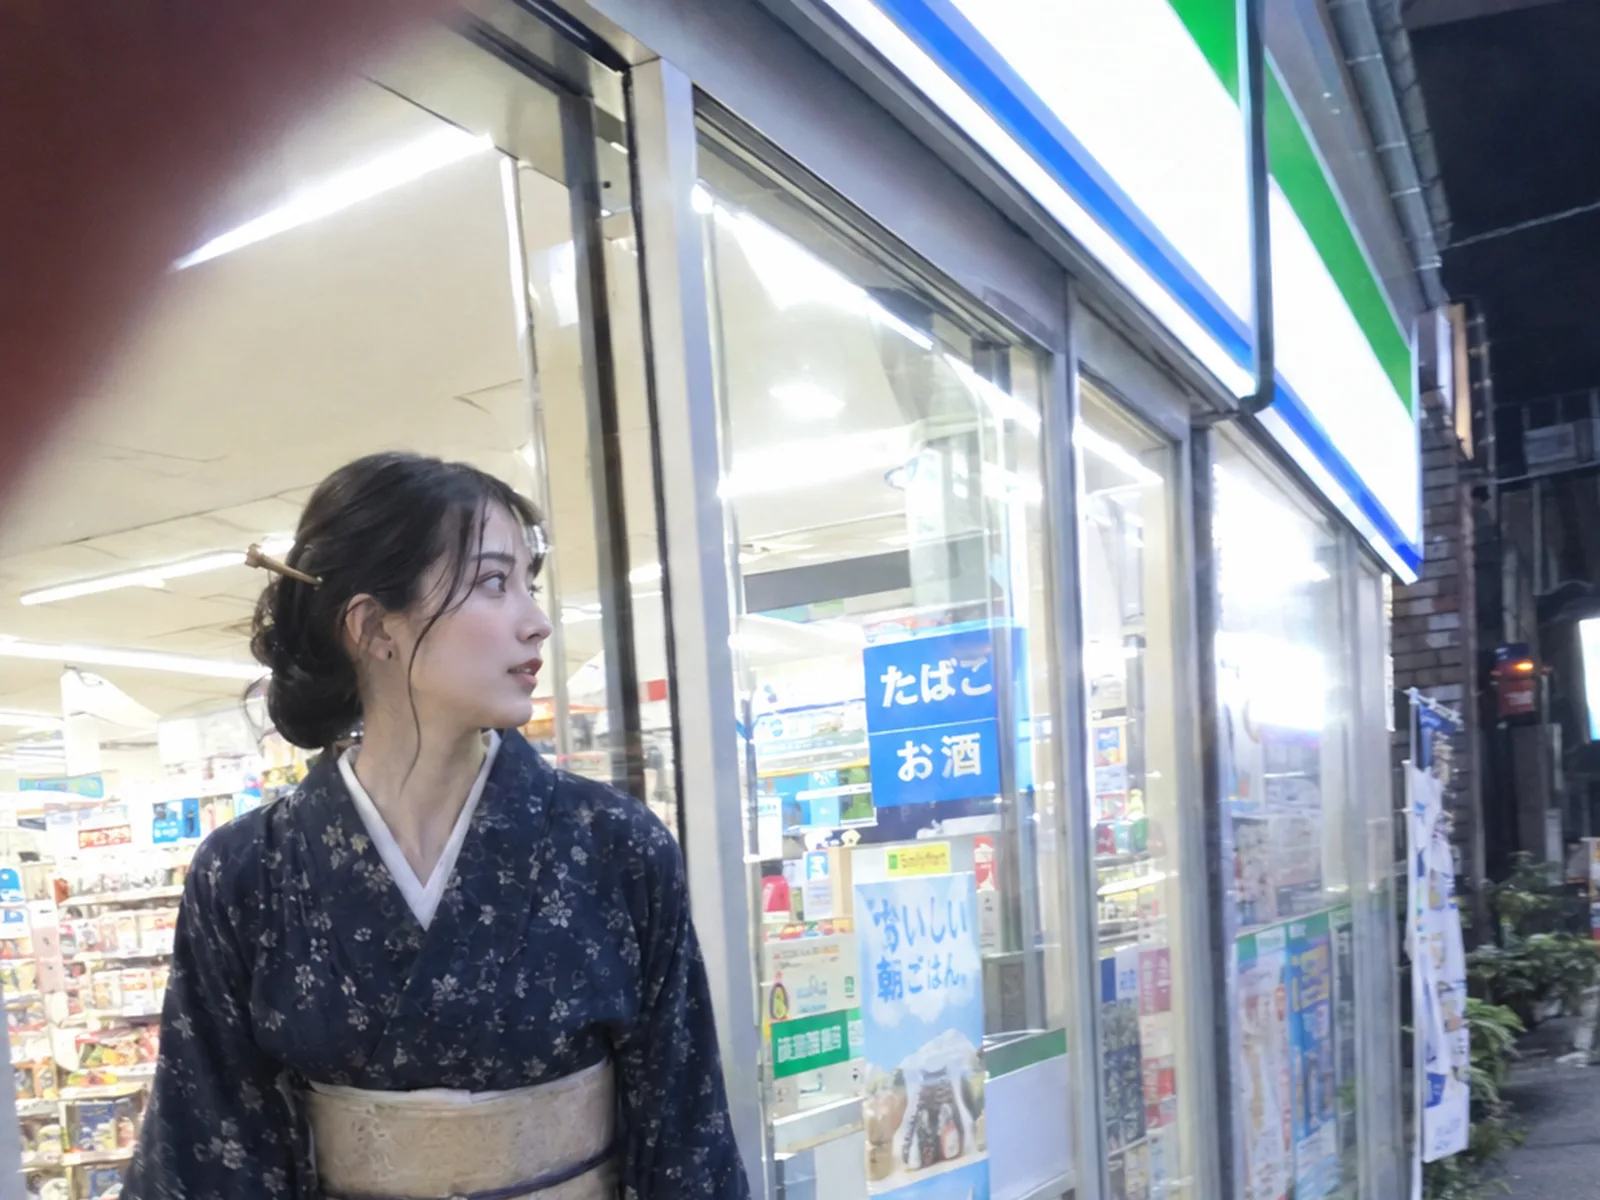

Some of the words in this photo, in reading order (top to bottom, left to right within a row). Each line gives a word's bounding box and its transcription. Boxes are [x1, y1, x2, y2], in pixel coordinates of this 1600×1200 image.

[880, 657, 992, 708] たばこ
[897, 732, 982, 782] お酒
